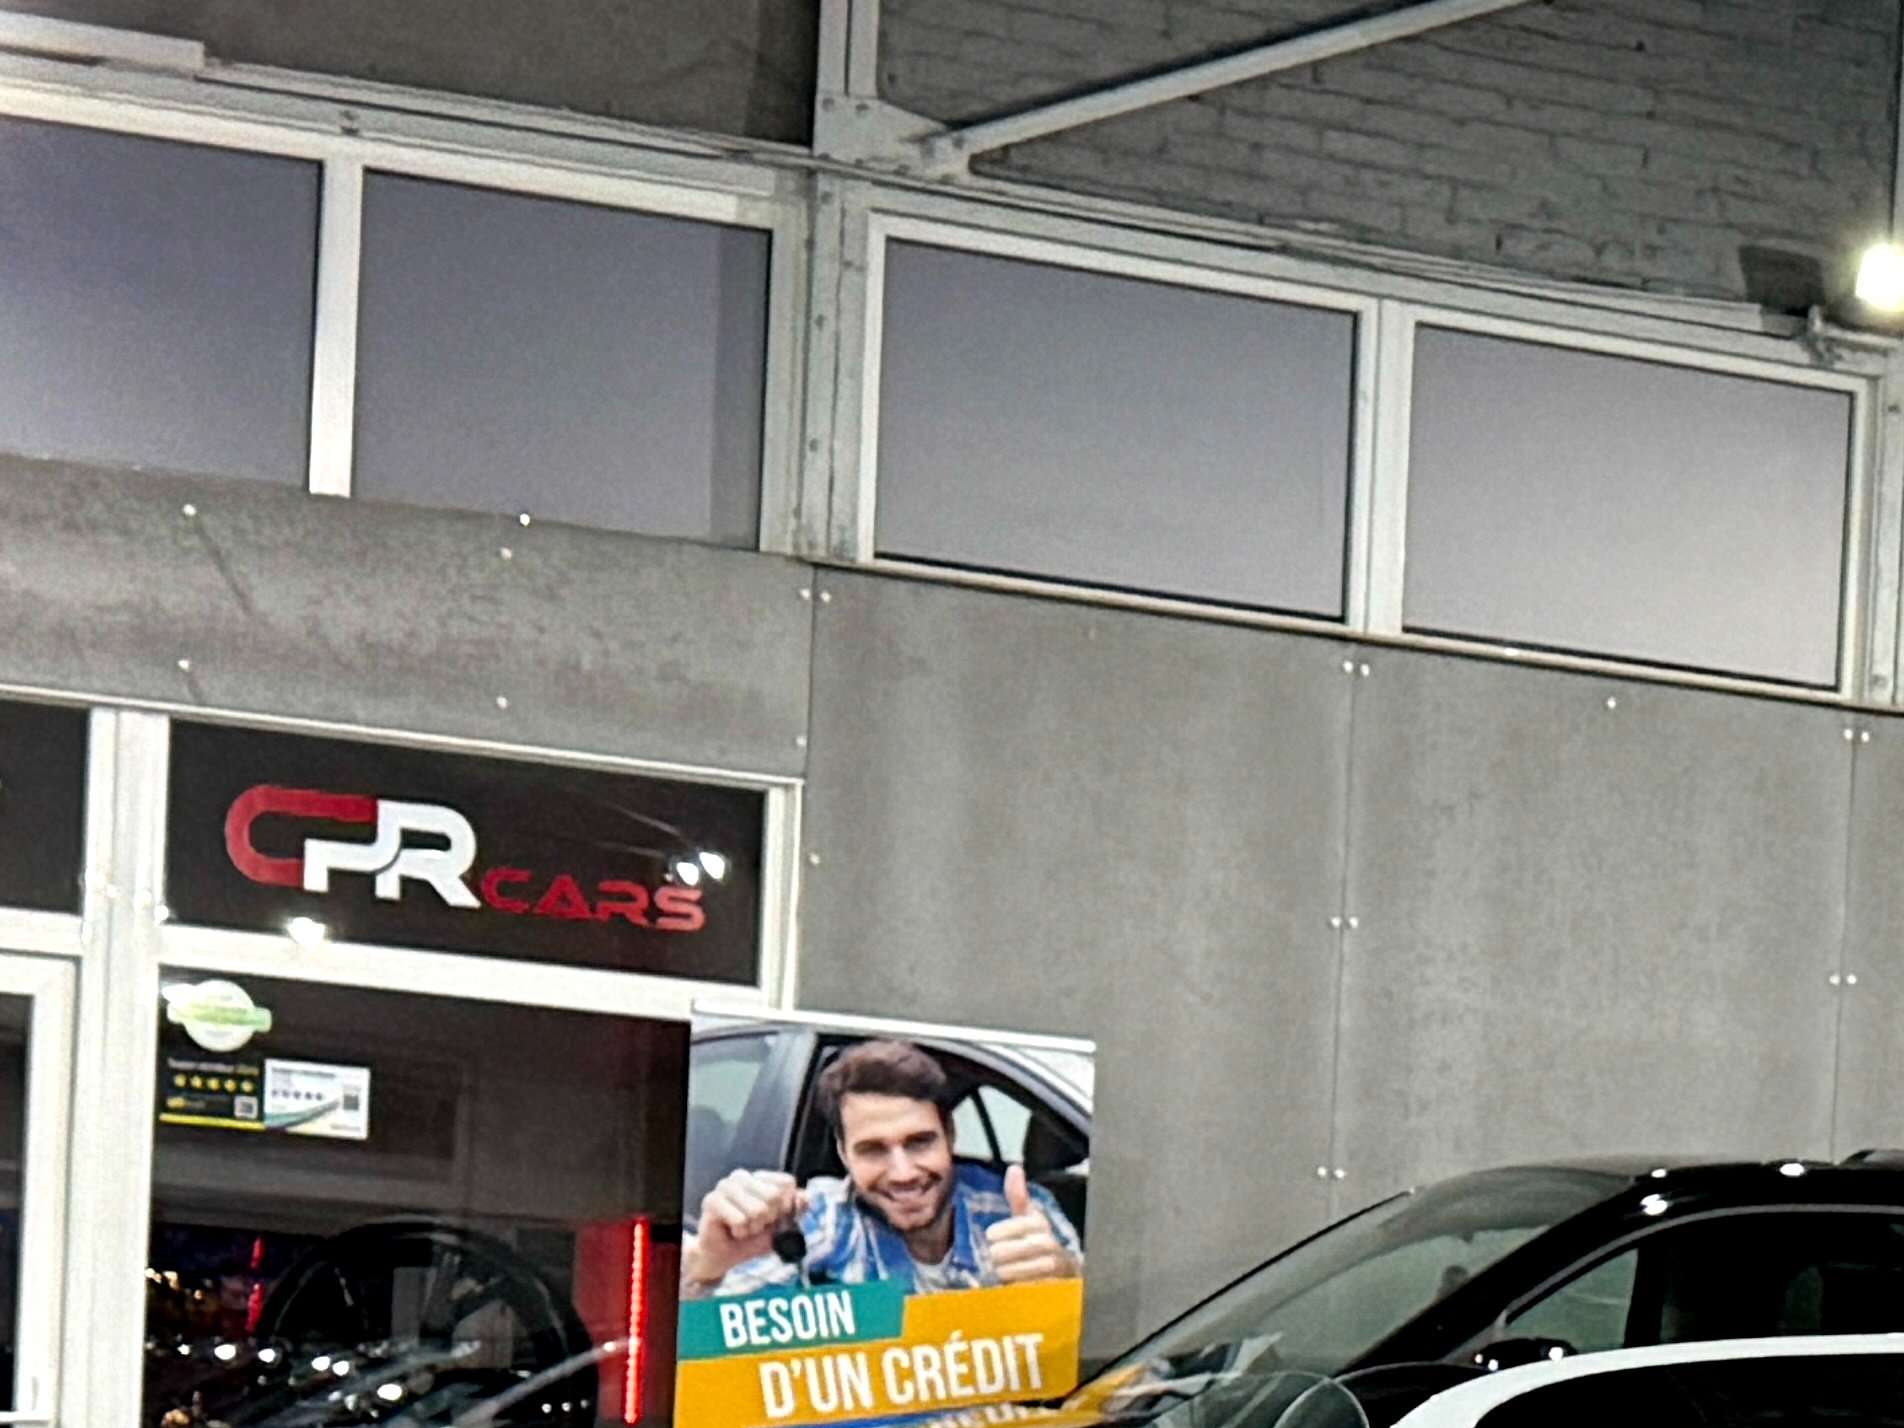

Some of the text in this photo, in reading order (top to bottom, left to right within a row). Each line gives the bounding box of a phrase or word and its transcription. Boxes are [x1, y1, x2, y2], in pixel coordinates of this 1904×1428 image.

[224, 784, 706, 932] CPR CARS
[719, 1290, 856, 1348] BESOIN
[760, 1330, 1044, 1419] D'UN CRÉDIT
